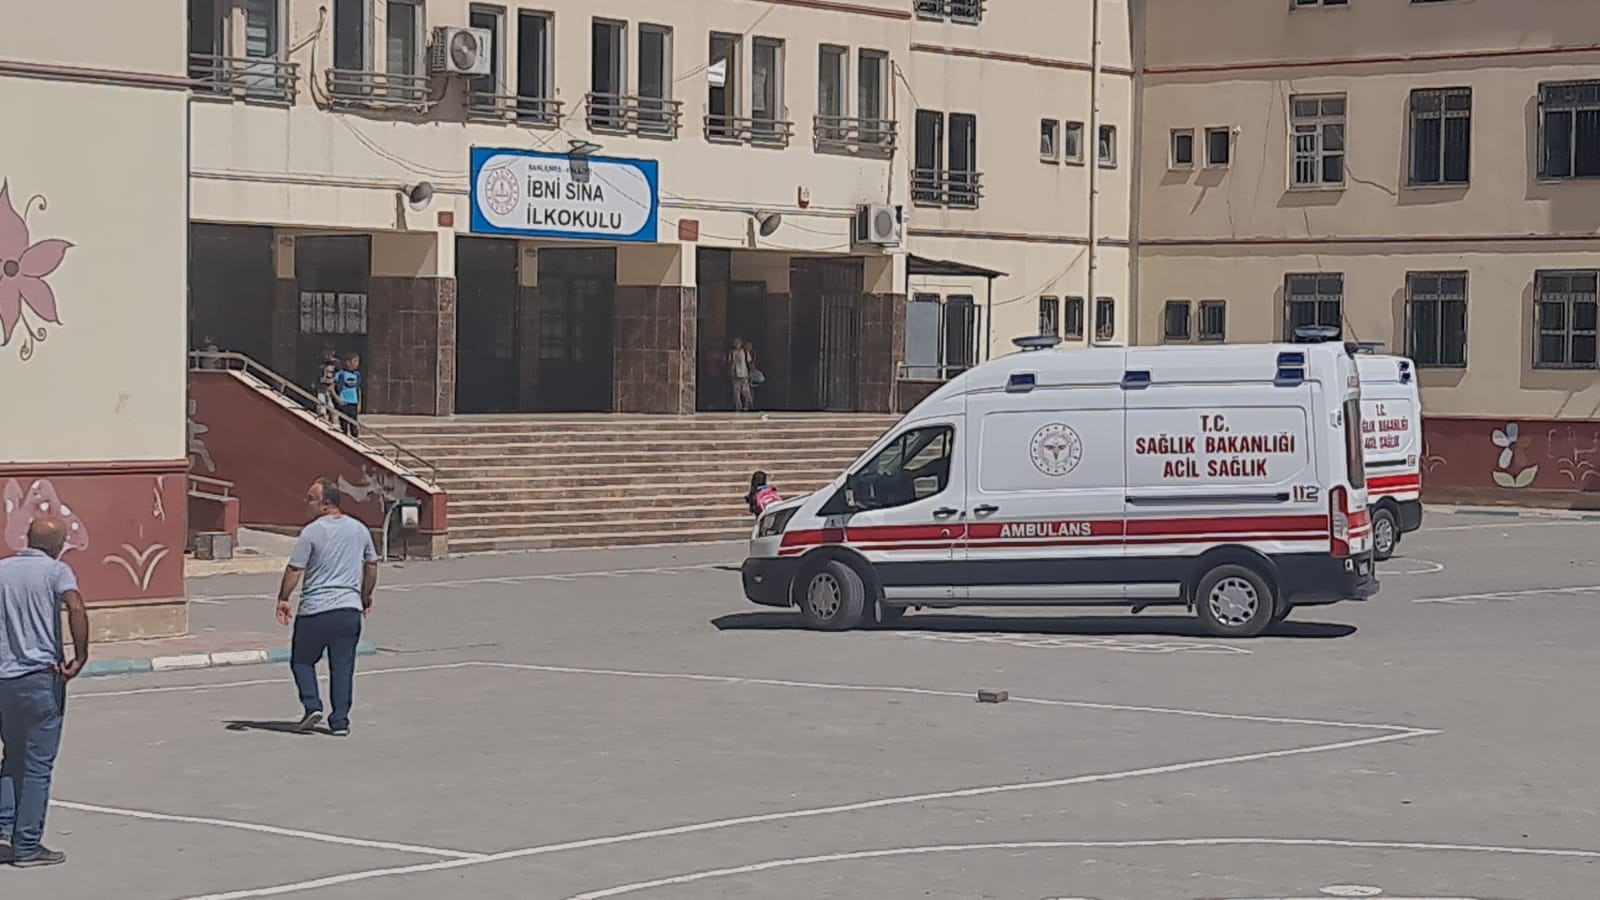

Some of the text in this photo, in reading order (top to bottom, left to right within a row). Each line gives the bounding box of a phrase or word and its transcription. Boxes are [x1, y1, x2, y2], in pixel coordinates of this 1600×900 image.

[527, 175, 560, 199] İBNİ
[527, 203, 622, 229] İLKOKULU
[1200, 414, 1229, 432] T.C.
[1135, 432, 1295, 454] SAĞLIK BAKANLIĞI
[1163, 456, 1267, 478] ACİL SAĞLIK
[1293, 485, 1319, 502] 112
[1000, 522, 1092, 537] AMBULANS
